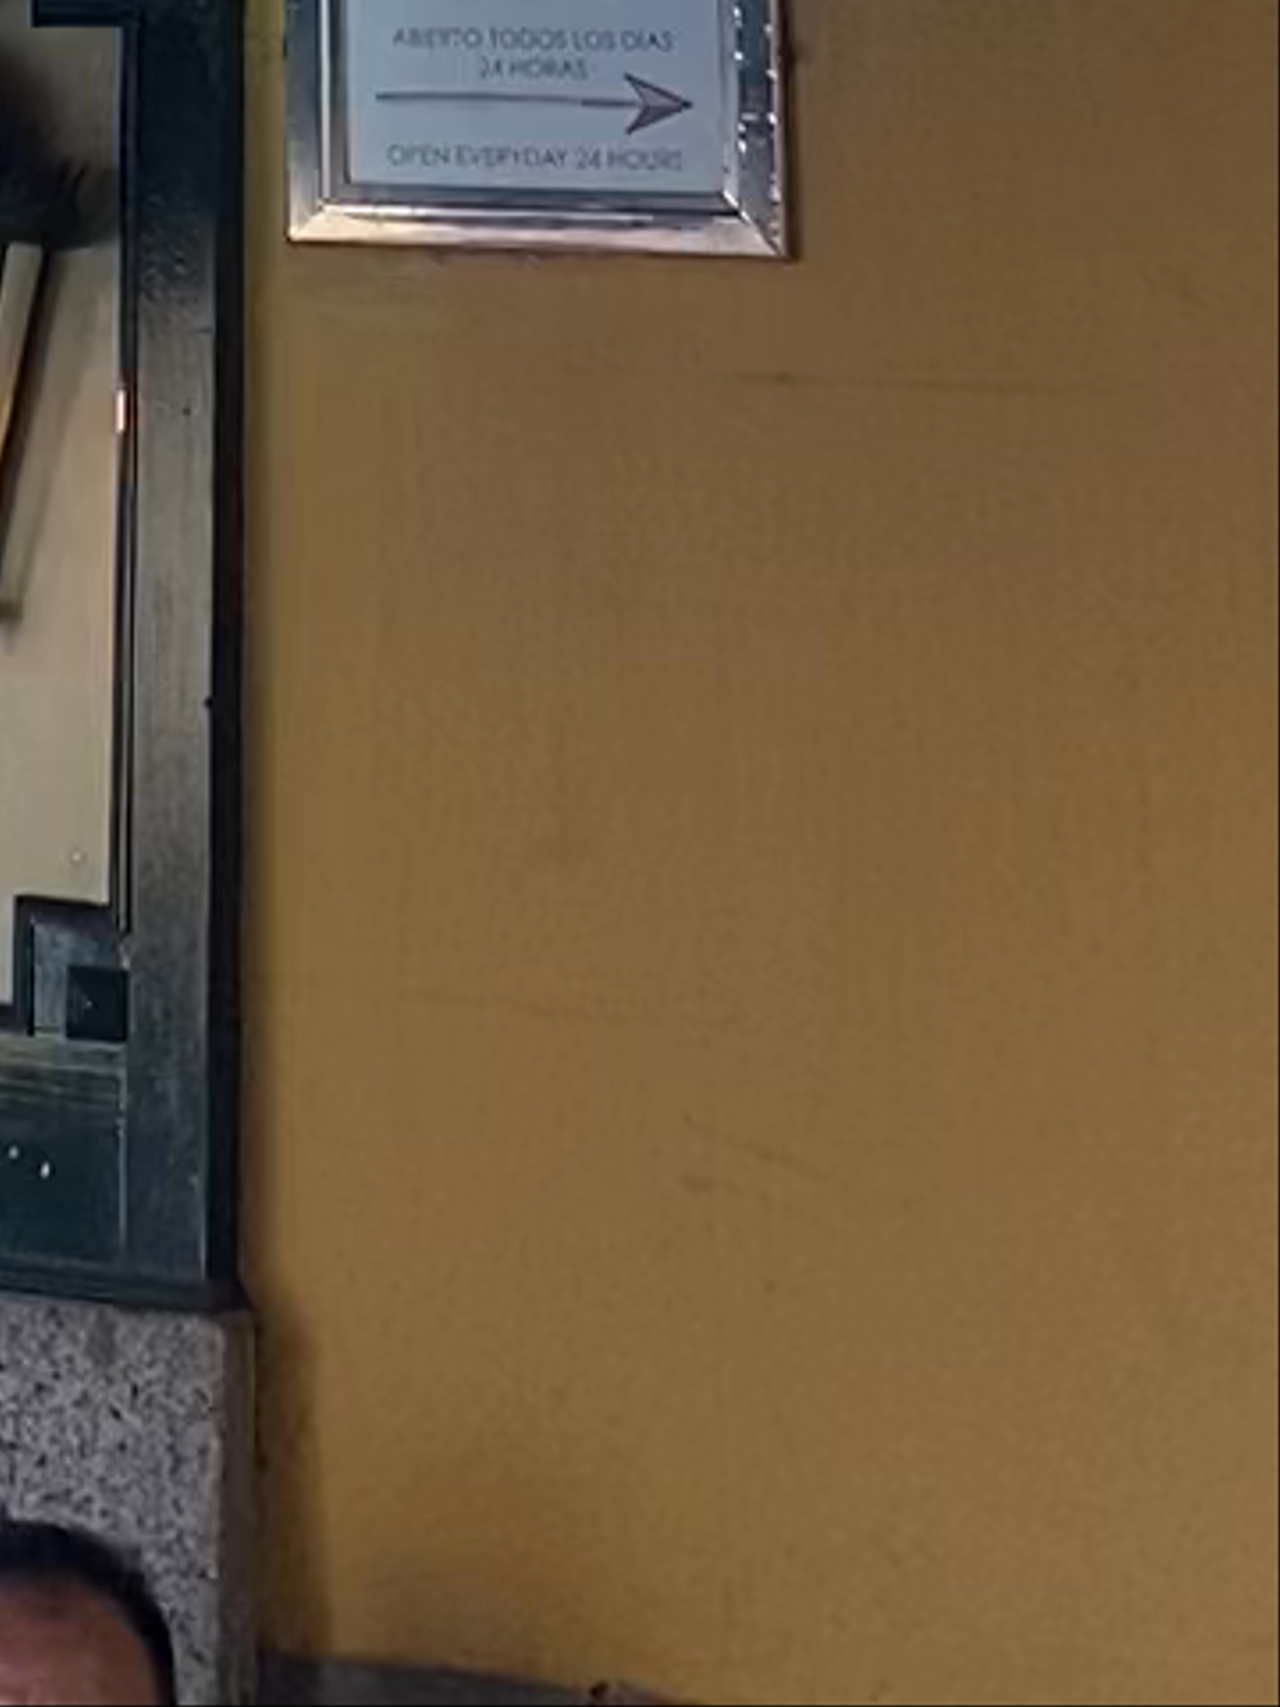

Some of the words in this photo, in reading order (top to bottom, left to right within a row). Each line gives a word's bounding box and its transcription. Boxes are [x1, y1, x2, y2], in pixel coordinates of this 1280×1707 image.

[489, 28, 566, 50] TODOS
[573, 29, 616, 51] LOS
[479, 56, 503, 79] 24
[508, 56, 589, 80] HORAS
[386, 145, 450, 168] OPEN
[574, 147, 602, 170] 24
[606, 147, 684, 172] HOURS
